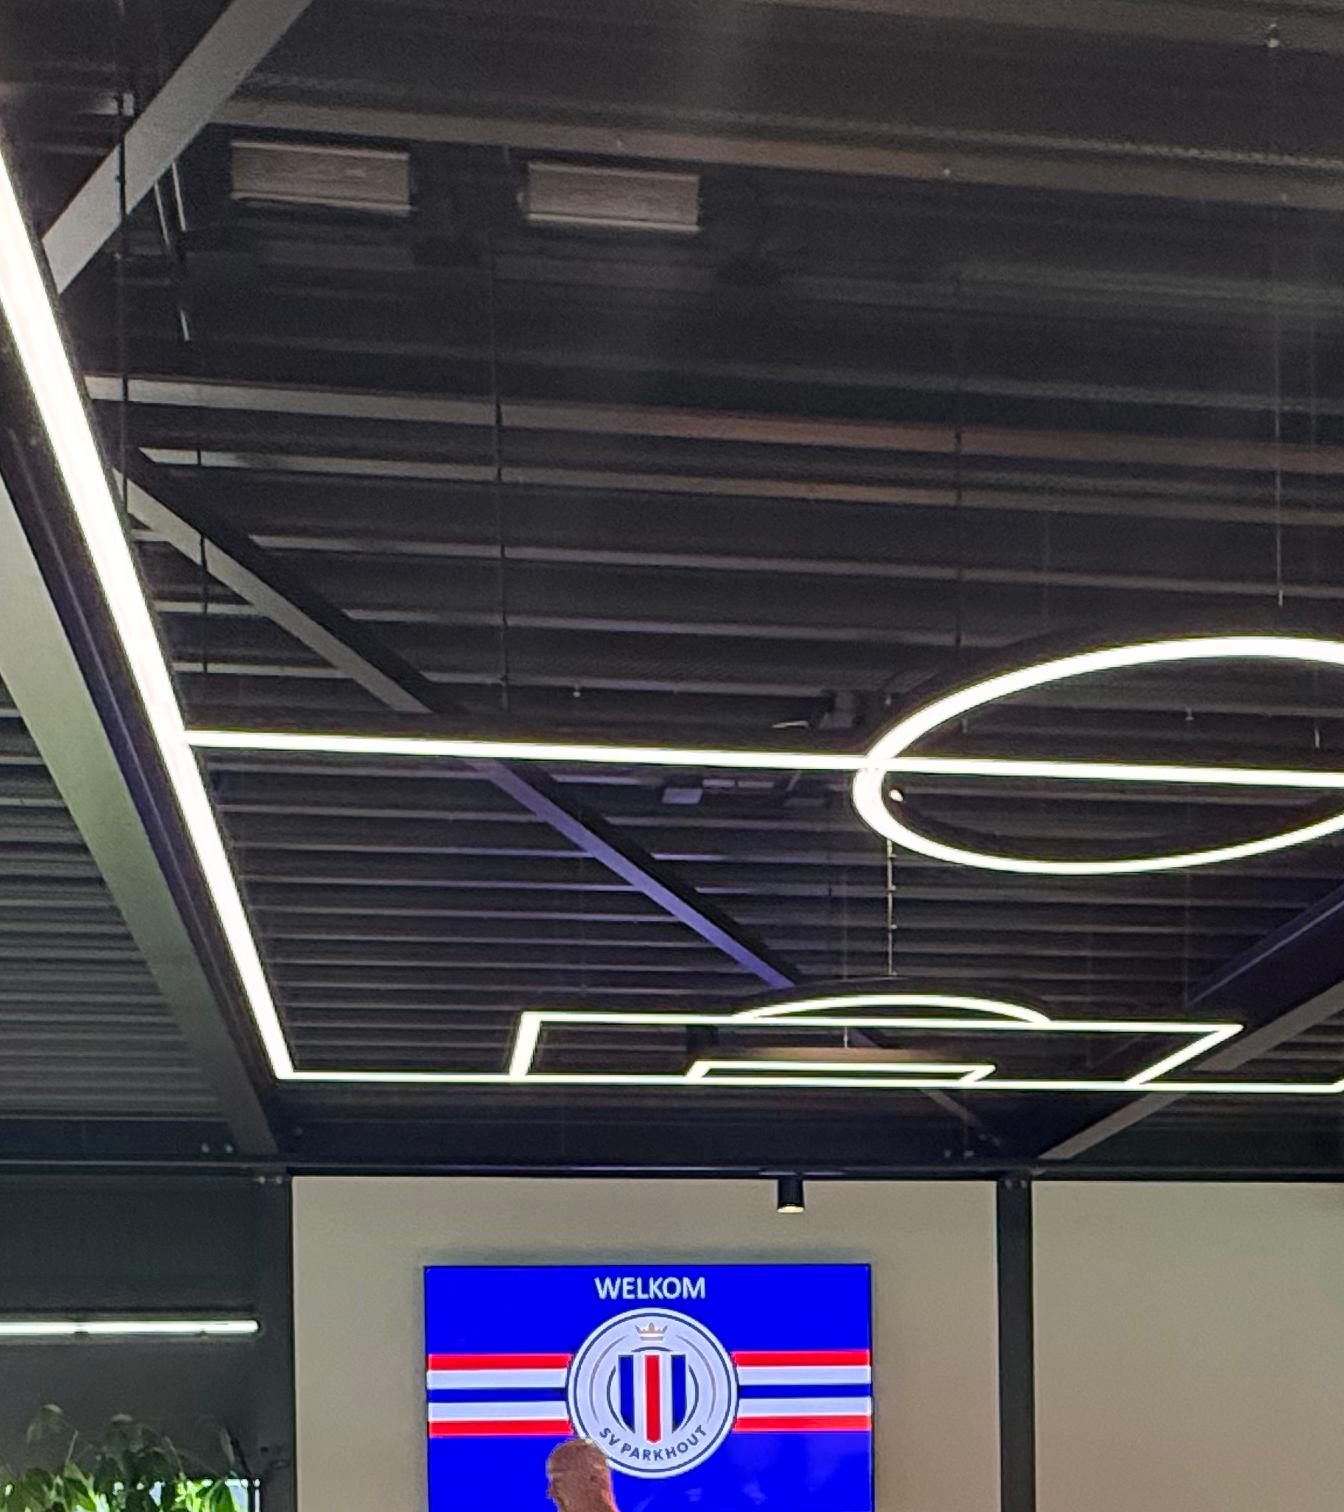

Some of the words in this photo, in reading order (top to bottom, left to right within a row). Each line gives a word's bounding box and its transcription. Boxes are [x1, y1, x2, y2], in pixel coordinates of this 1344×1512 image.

[594, 1276, 706, 1300] WELKOM
[599, 1427, 621, 1446] SV
[620, 1424, 707, 1461] PARKHOUT
